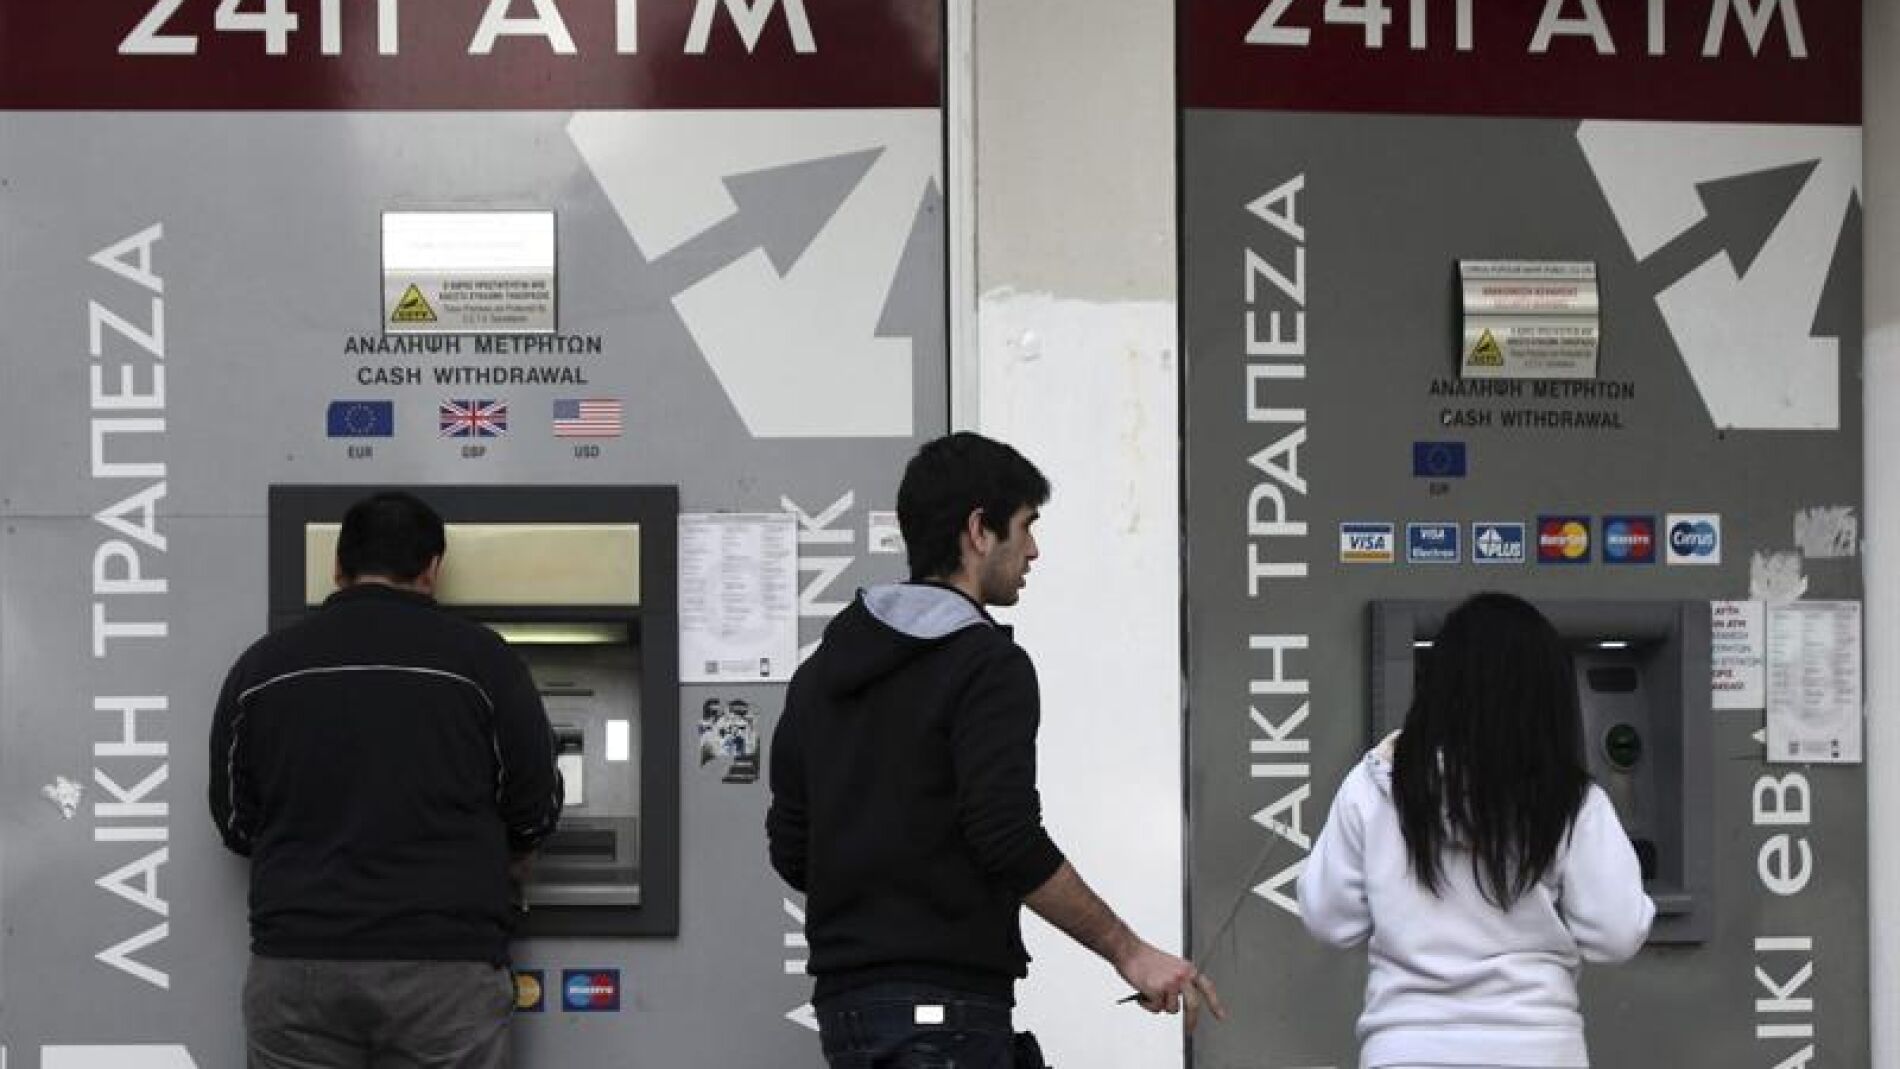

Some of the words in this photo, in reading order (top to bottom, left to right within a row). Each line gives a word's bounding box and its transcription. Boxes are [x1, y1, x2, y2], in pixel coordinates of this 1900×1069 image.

[357, 367, 422, 385] CASH
[434, 367, 589, 385] WITHDRAWAL
[1245, 173, 1308, 597] ΤΡΑΠΕΖΑ
[1440, 408, 1492, 426] CASH
[1500, 410, 1624, 429] WITHDRAWAL
[88, 222, 168, 658] ΤΡΑΠΕΖΑ
[348, 446, 374, 459] EUR
[574, 445, 600, 459] USD
[1419, 528, 1445, 539] VISA
[1674, 530, 1714, 546] Cirrus
[1351, 535, 1386, 549] VISA
[1490, 543, 1521, 557] PLUS
